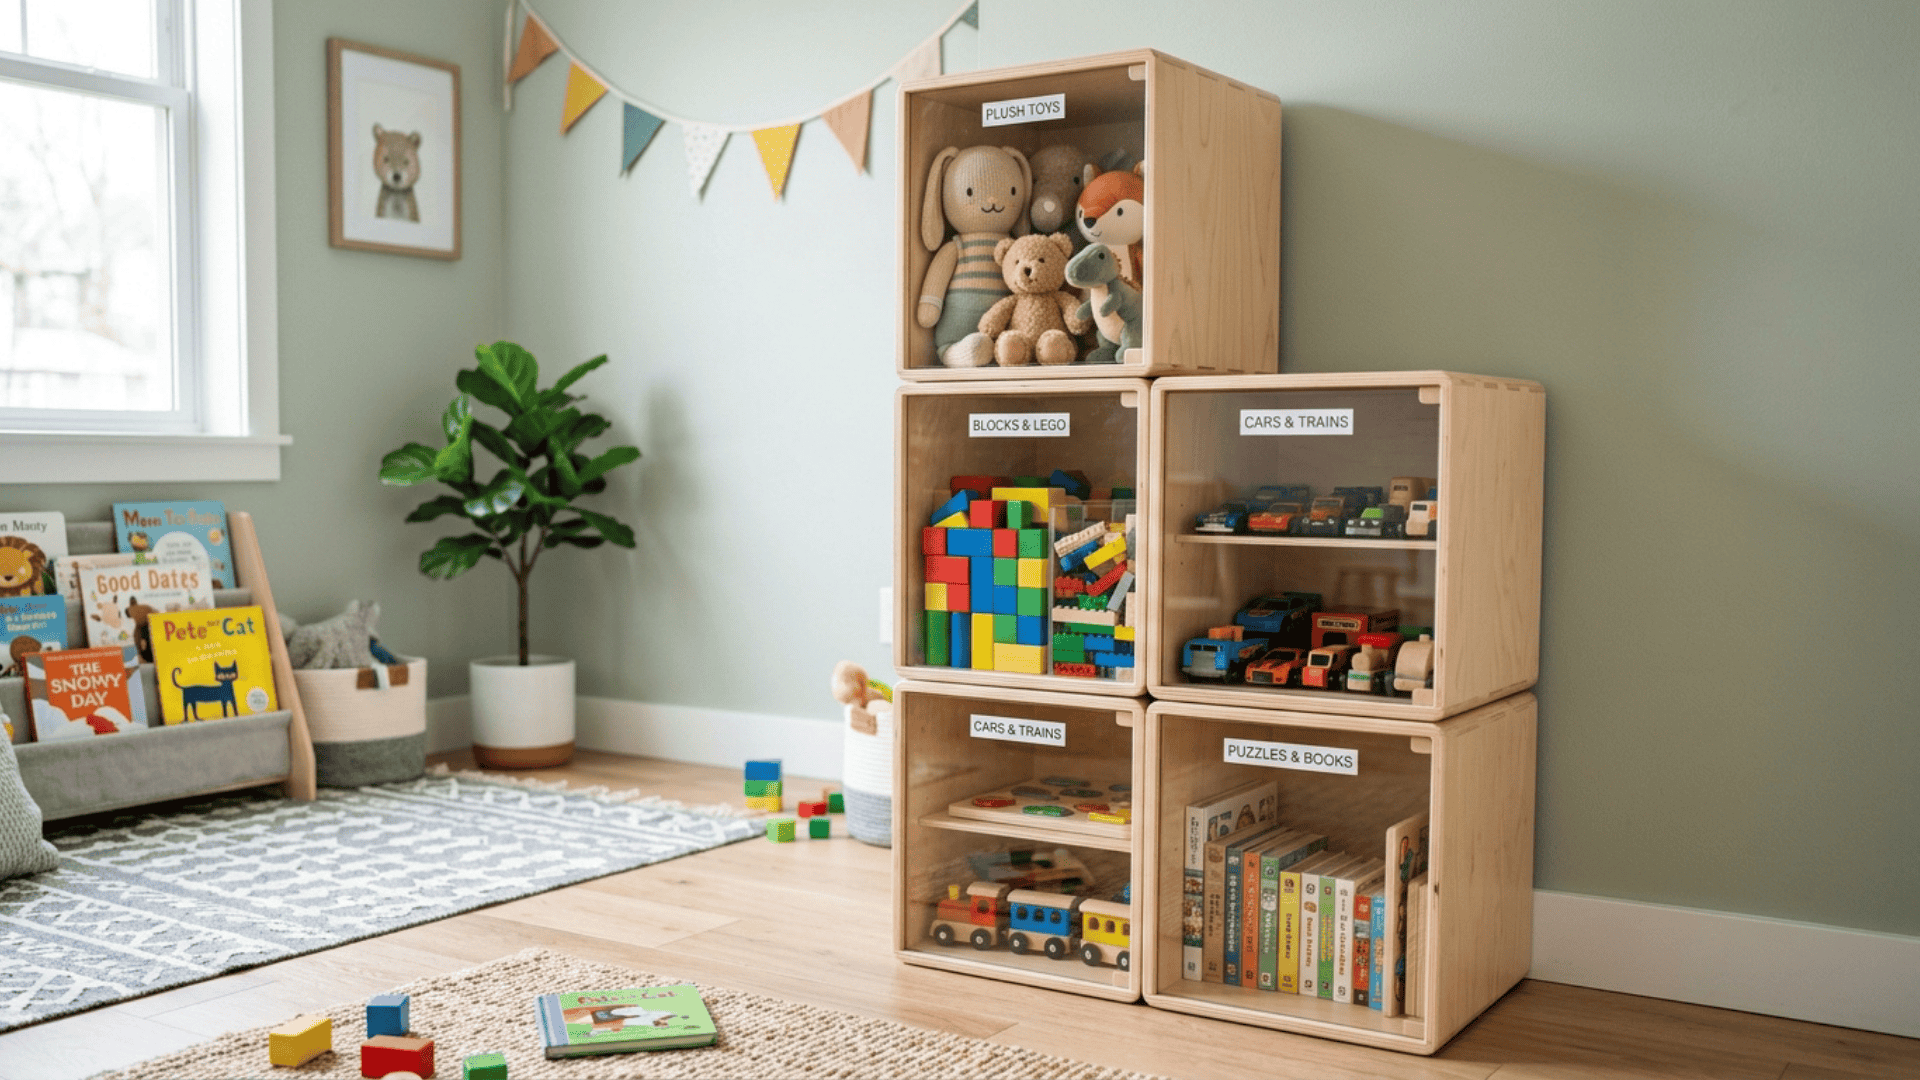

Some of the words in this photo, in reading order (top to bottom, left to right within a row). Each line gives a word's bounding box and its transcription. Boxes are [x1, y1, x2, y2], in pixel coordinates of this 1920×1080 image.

[986, 105, 1025, 120] PLUSH
[1027, 101, 1060, 116] TOYS
[973, 419, 1020, 431] BLOCKS
[1021, 419, 1031, 431] &
[1033, 418, 1067, 431] LEGO
[1244, 415, 1281, 429] CARS
[1284, 415, 1294, 428] &
[1297, 415, 1349, 428] TRAINS
[221, 616, 256, 636] Cat
[69, 661, 101, 675] THE
[70, 691, 108, 709] DAY
[973, 720, 1005, 734] CARS
[1007, 723, 1016, 735] &
[1019, 724, 1062, 740] TRAINS
[1227, 744, 1287, 761] PUZZLES
[1290, 750, 1300, 763] &
[1303, 751, 1353, 768] BOOKS
